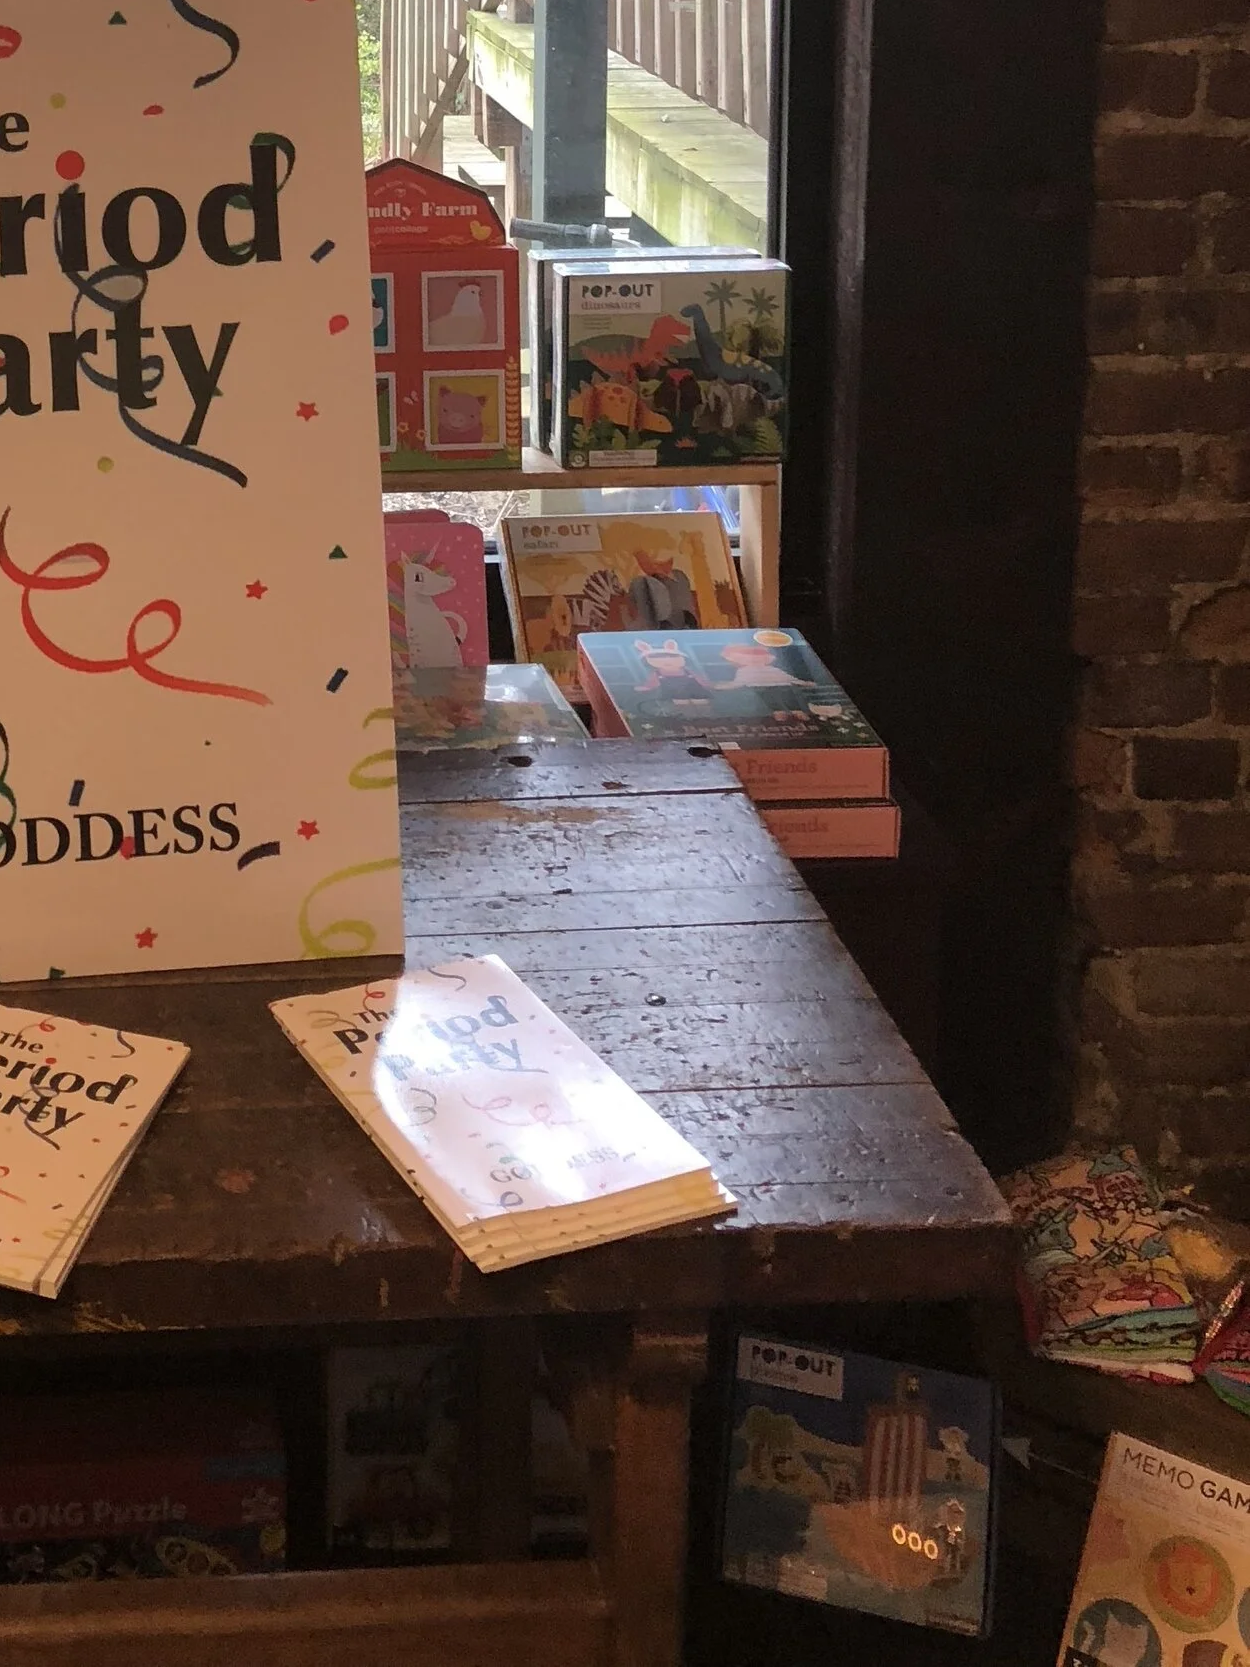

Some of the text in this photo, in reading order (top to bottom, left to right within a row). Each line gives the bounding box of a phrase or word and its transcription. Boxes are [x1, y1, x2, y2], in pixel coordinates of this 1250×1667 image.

[422, 202, 478, 217] Farm
[581, 283, 654, 299] POP-OUT
[581, 300, 641, 311] dinosaurs
[522, 524, 592, 539] POP-OUT
[523, 540, 559, 550] safari
[746, 758, 819, 774] Friends
[352, 1008, 395, 1024] Th
[333, 995, 520, 1055] Piod
[381, 1037, 526, 1082] Prty
[751, 1345, 836, 1377] POP-OUT
[1123, 1447, 1194, 1490] MEMO
[92, 1493, 187, 1525] Puzzle
